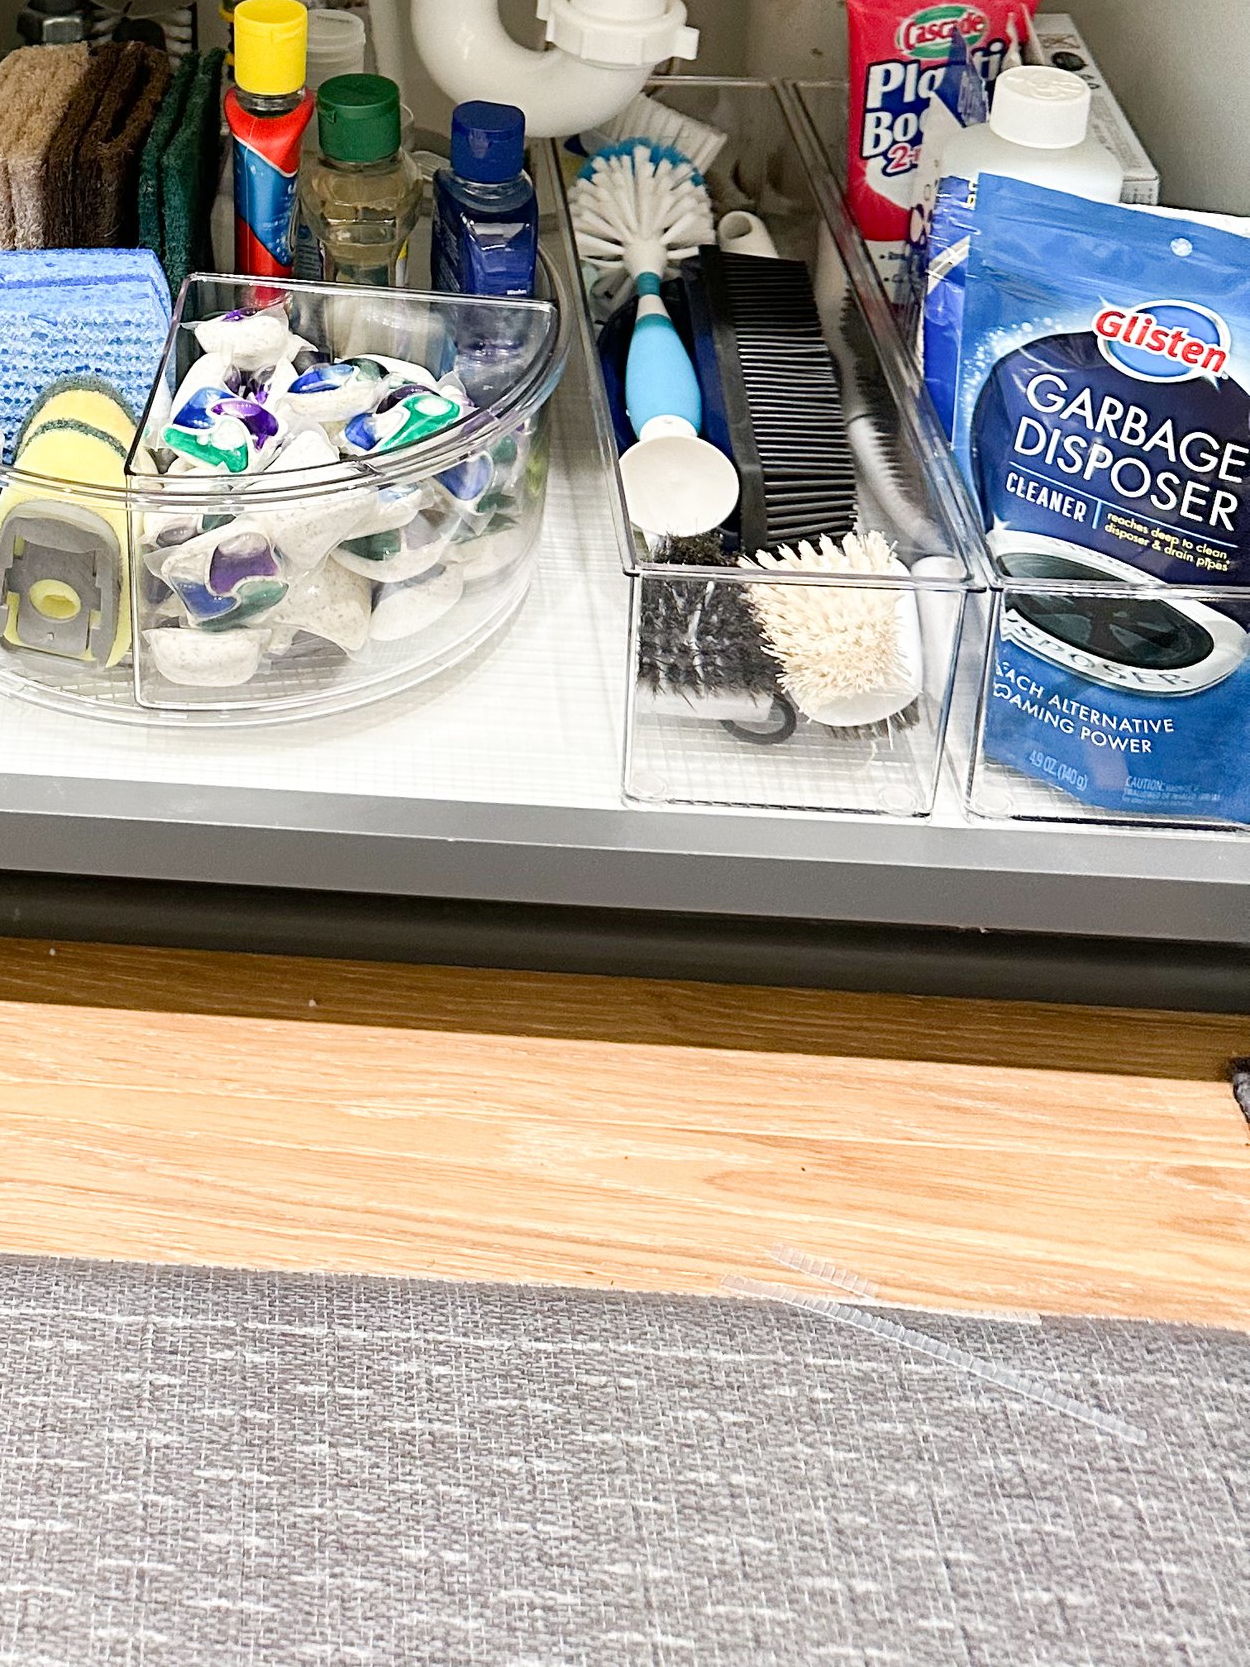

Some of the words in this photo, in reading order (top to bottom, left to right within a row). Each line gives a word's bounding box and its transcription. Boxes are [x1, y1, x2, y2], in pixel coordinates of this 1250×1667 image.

[865, 39, 1004, 109] Plati
[861, 111, 924, 158] Bo
[1096, 308, 1228, 375] Glisten
[1026, 373, 1250, 484] GARBAGE
[1005, 472, 1088, 523] CLEANER
[1013, 416, 1239, 532] DISPOSER
[1104, 521, 1150, 548] disposer
[1151, 538, 1162, 552] &
[1164, 542, 1195, 563] drain
[1106, 512, 1150, 535] reaches
[1150, 523, 1180, 549] deep
[1182, 536, 1194, 550] to
[1196, 542, 1228, 560] clean
[1007, 617, 1190, 686] SPOSER
[993, 682, 1075, 734] OAMING
[1080, 725, 1152, 754] POWER
[996, 662, 1045, 699] ACH
[1048, 694, 1175, 734] ALTERNATIVE
